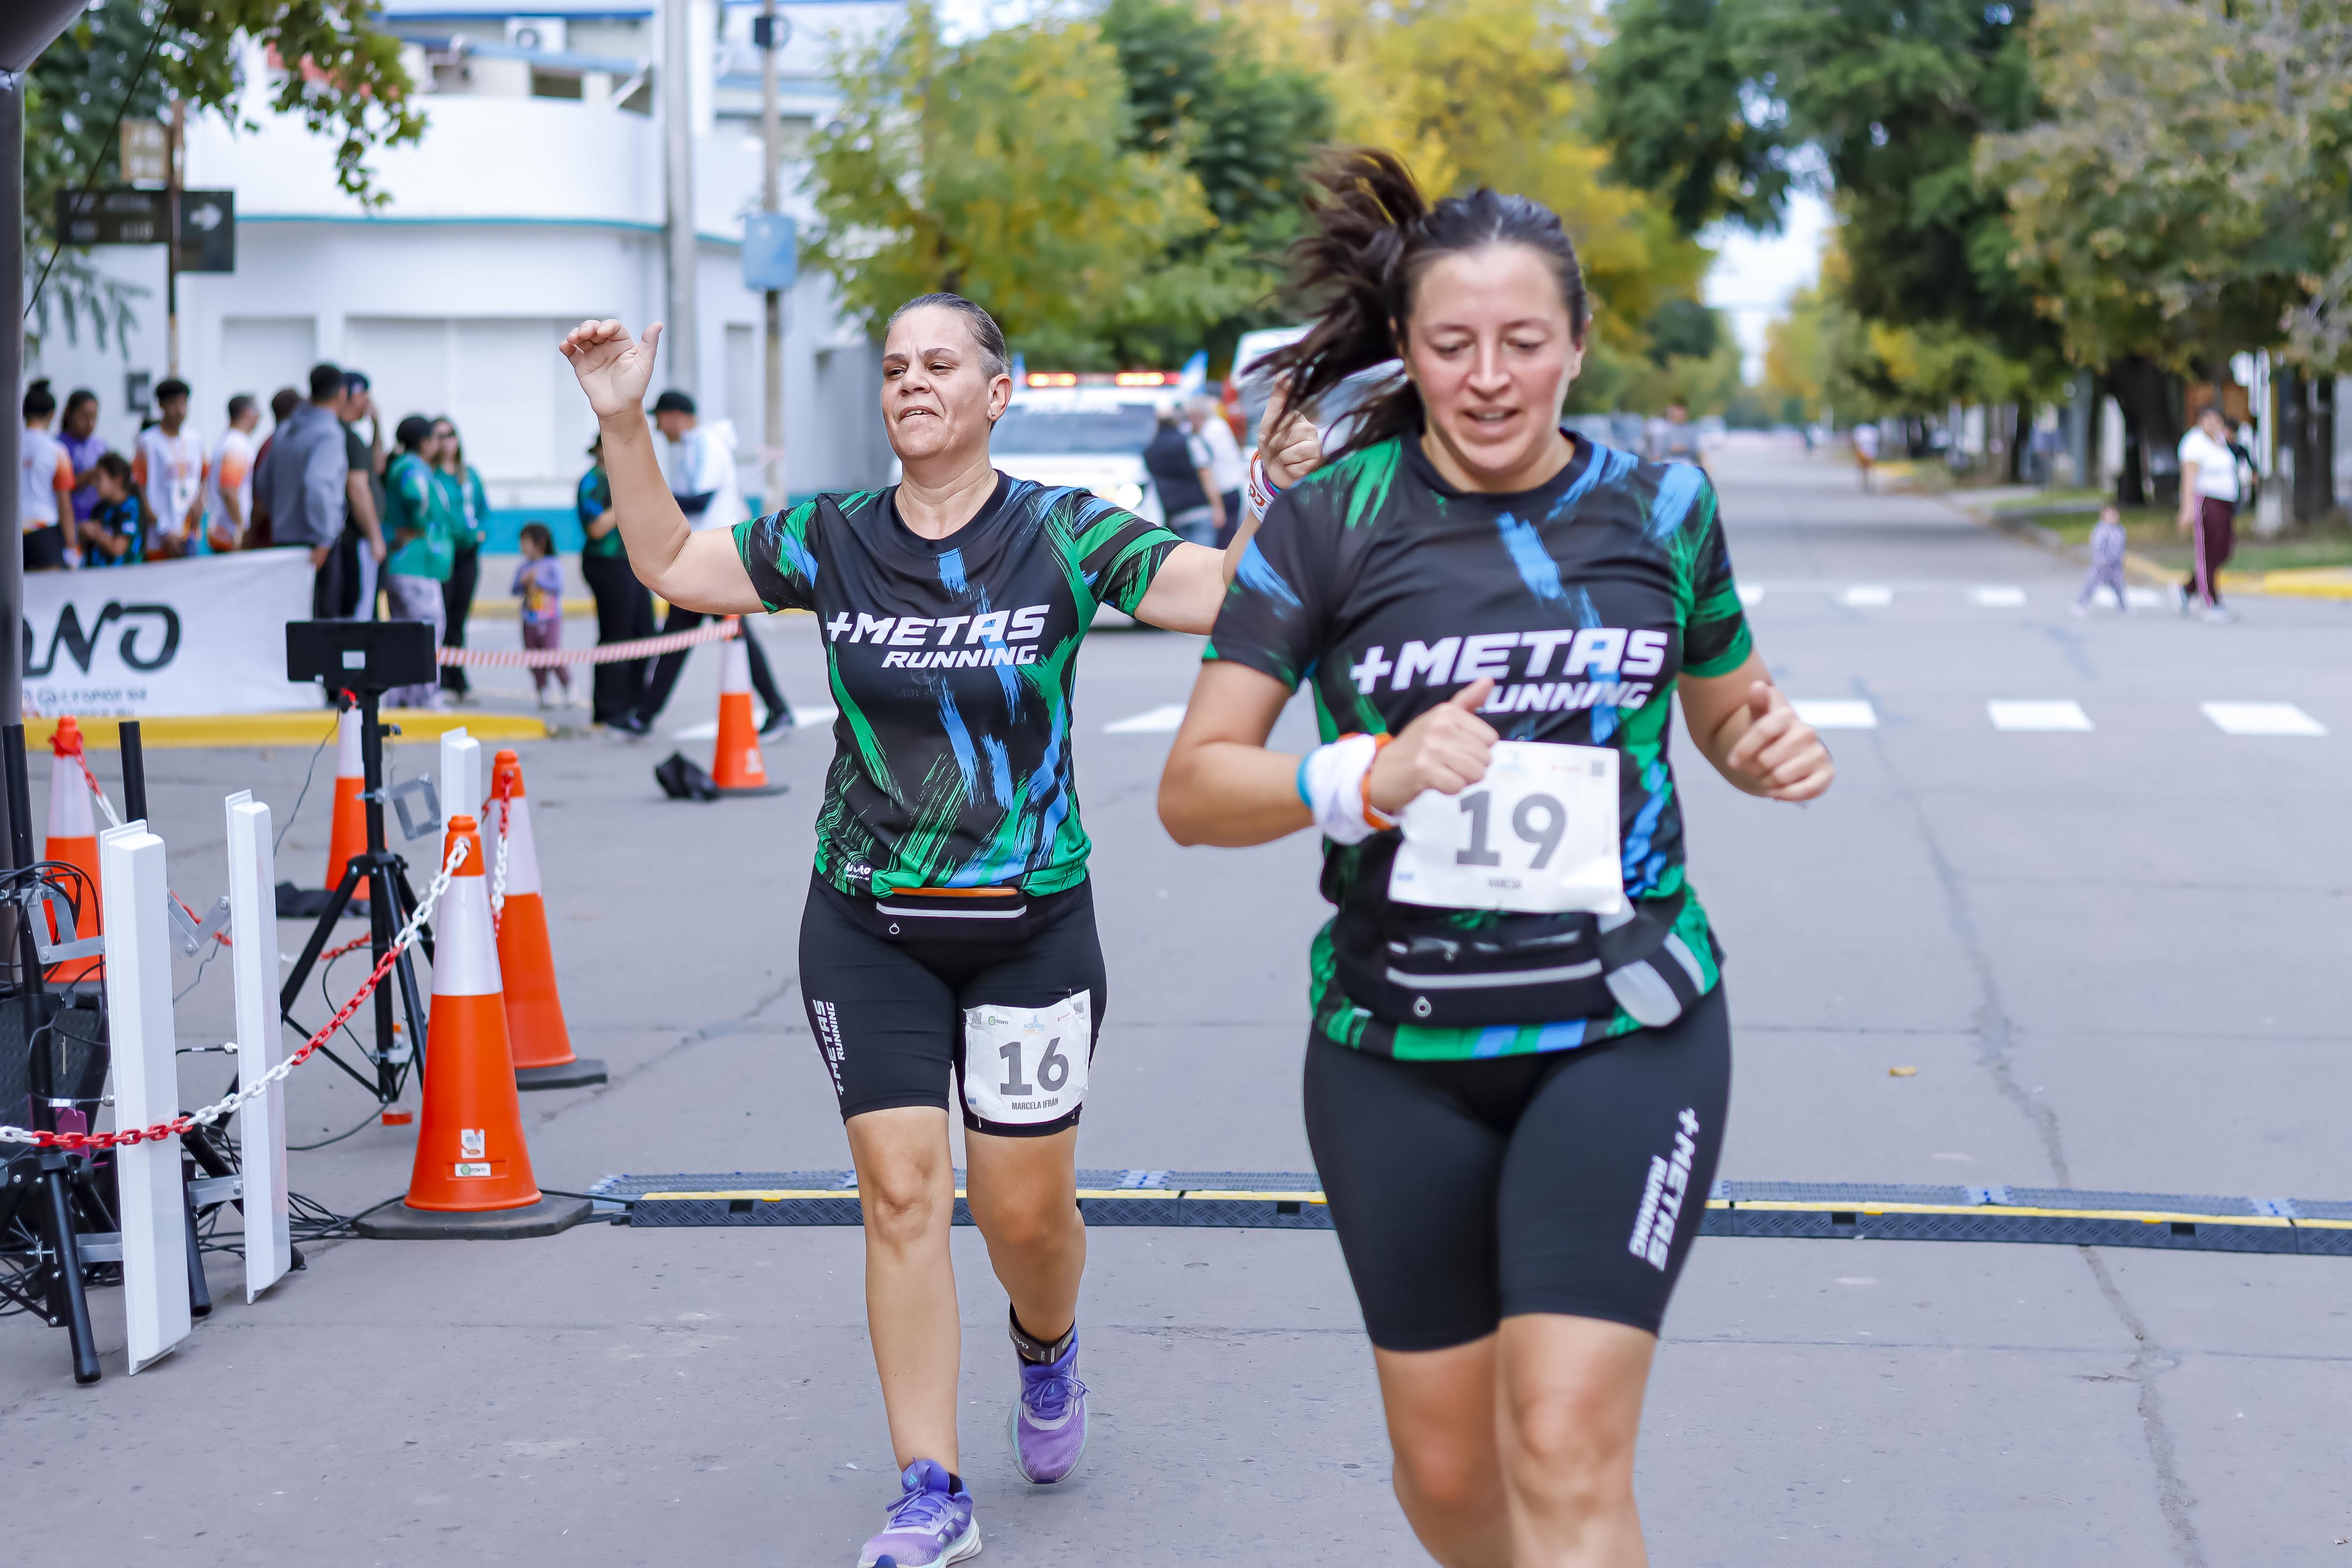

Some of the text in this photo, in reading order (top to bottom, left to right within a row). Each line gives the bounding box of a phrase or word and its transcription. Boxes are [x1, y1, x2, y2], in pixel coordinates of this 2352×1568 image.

[827, 605, 1051, 645] +METAS
[881, 644, 1038, 668] RUNNING
[1349, 628, 1667, 695] +METAS
[1476, 682, 1653, 713] UNNING
[1457, 791, 1566, 869] 19
[812, 999, 845, 1096] +METAS
[826, 1002, 845, 1061] RUNNING
[999, 1036, 1069, 1096] 16
[1012, 1097, 1058, 1110] MARCELA IFRÁN
[1628, 1155, 1668, 1258] RUNNING
[1646, 1107, 1699, 1272] +METAS
